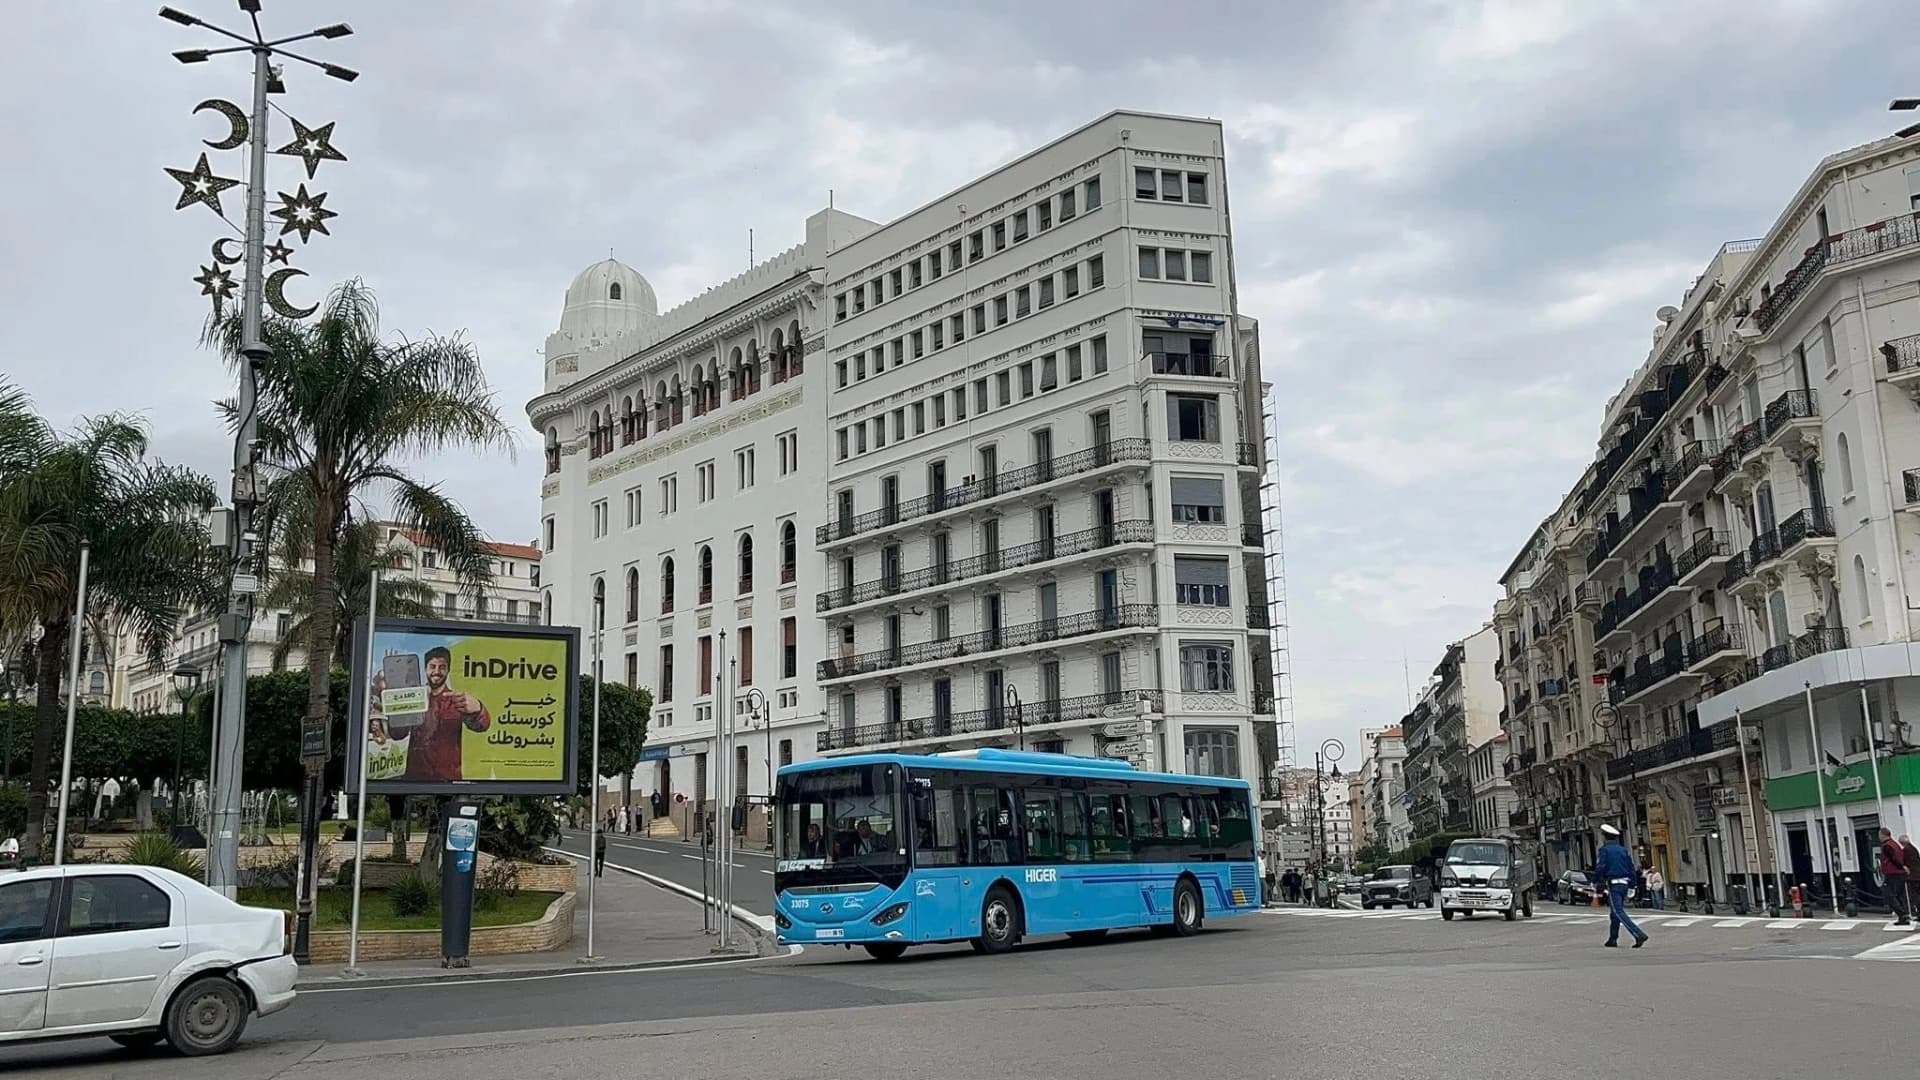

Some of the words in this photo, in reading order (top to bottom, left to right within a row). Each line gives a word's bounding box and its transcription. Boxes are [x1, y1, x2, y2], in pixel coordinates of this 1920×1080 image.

[463, 655, 558, 680] inDrive
[497, 711, 556, 729] كورستك
[487, 730, 555, 748] بشروطك
[369, 751, 404, 773] inDrive
[1025, 868, 1057, 883] HIGER
